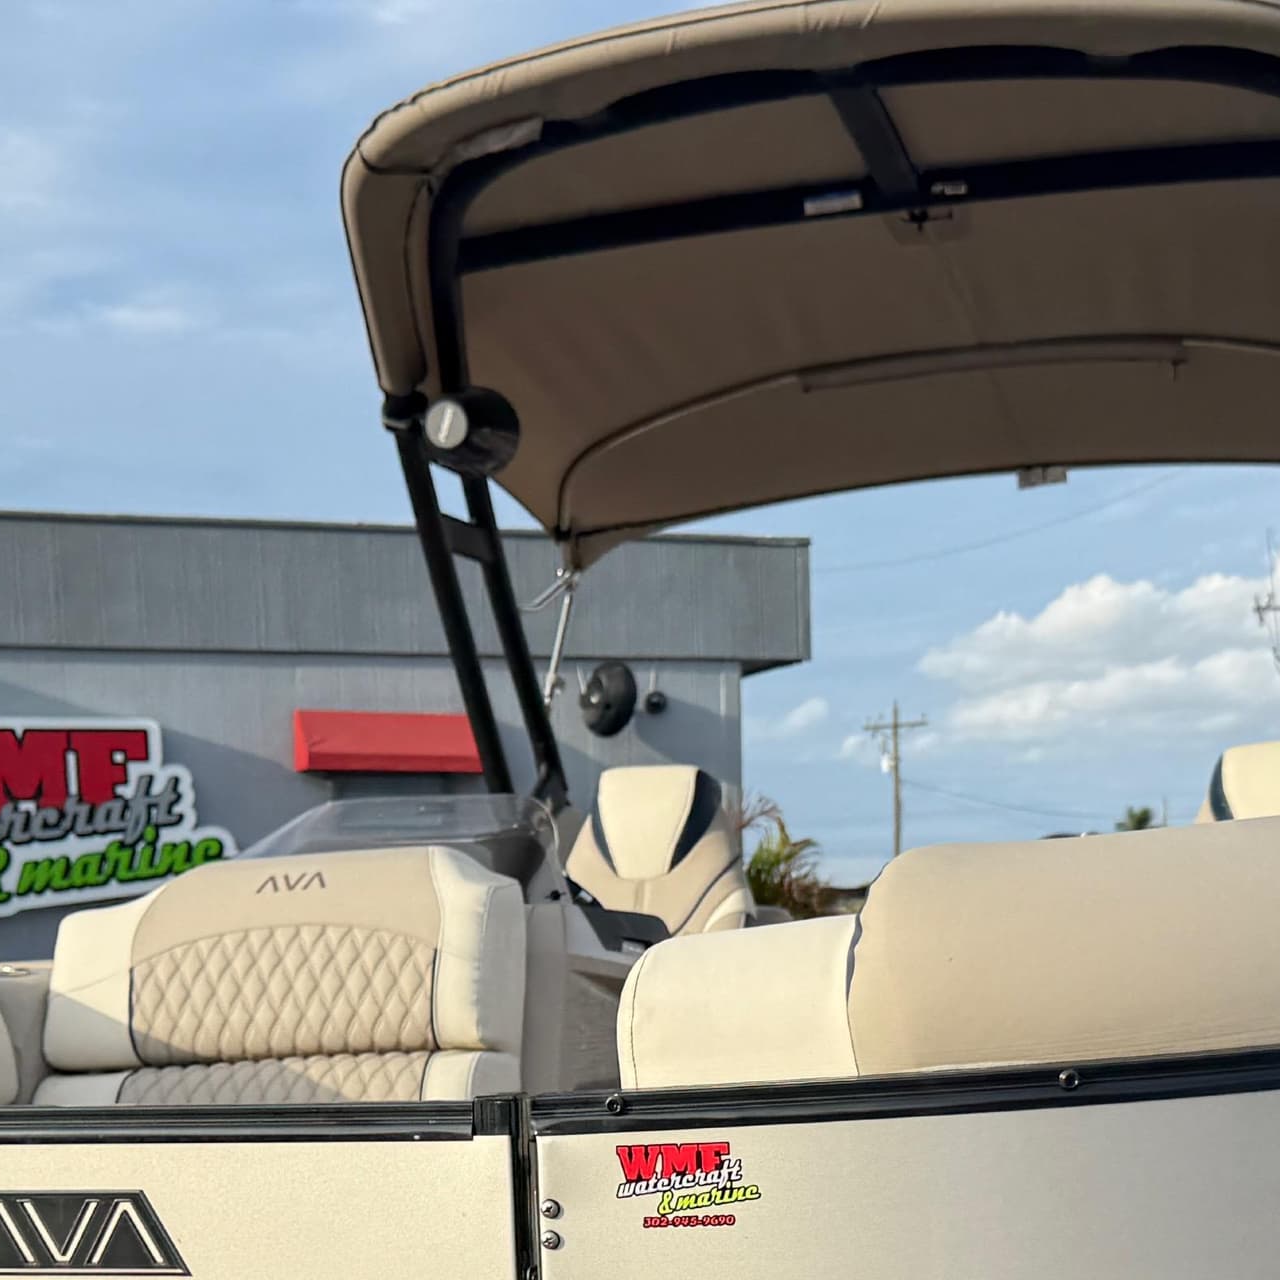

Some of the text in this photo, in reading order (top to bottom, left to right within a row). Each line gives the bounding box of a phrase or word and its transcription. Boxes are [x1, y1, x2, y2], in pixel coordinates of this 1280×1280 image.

[16, 824, 223, 896] marine
[616, 1142, 730, 1181] WMF
[617, 1159, 742, 1198] watercraft
[657, 1182, 761, 1215] & marine
[643, 1215, 736, 1228] 302-945-9690
